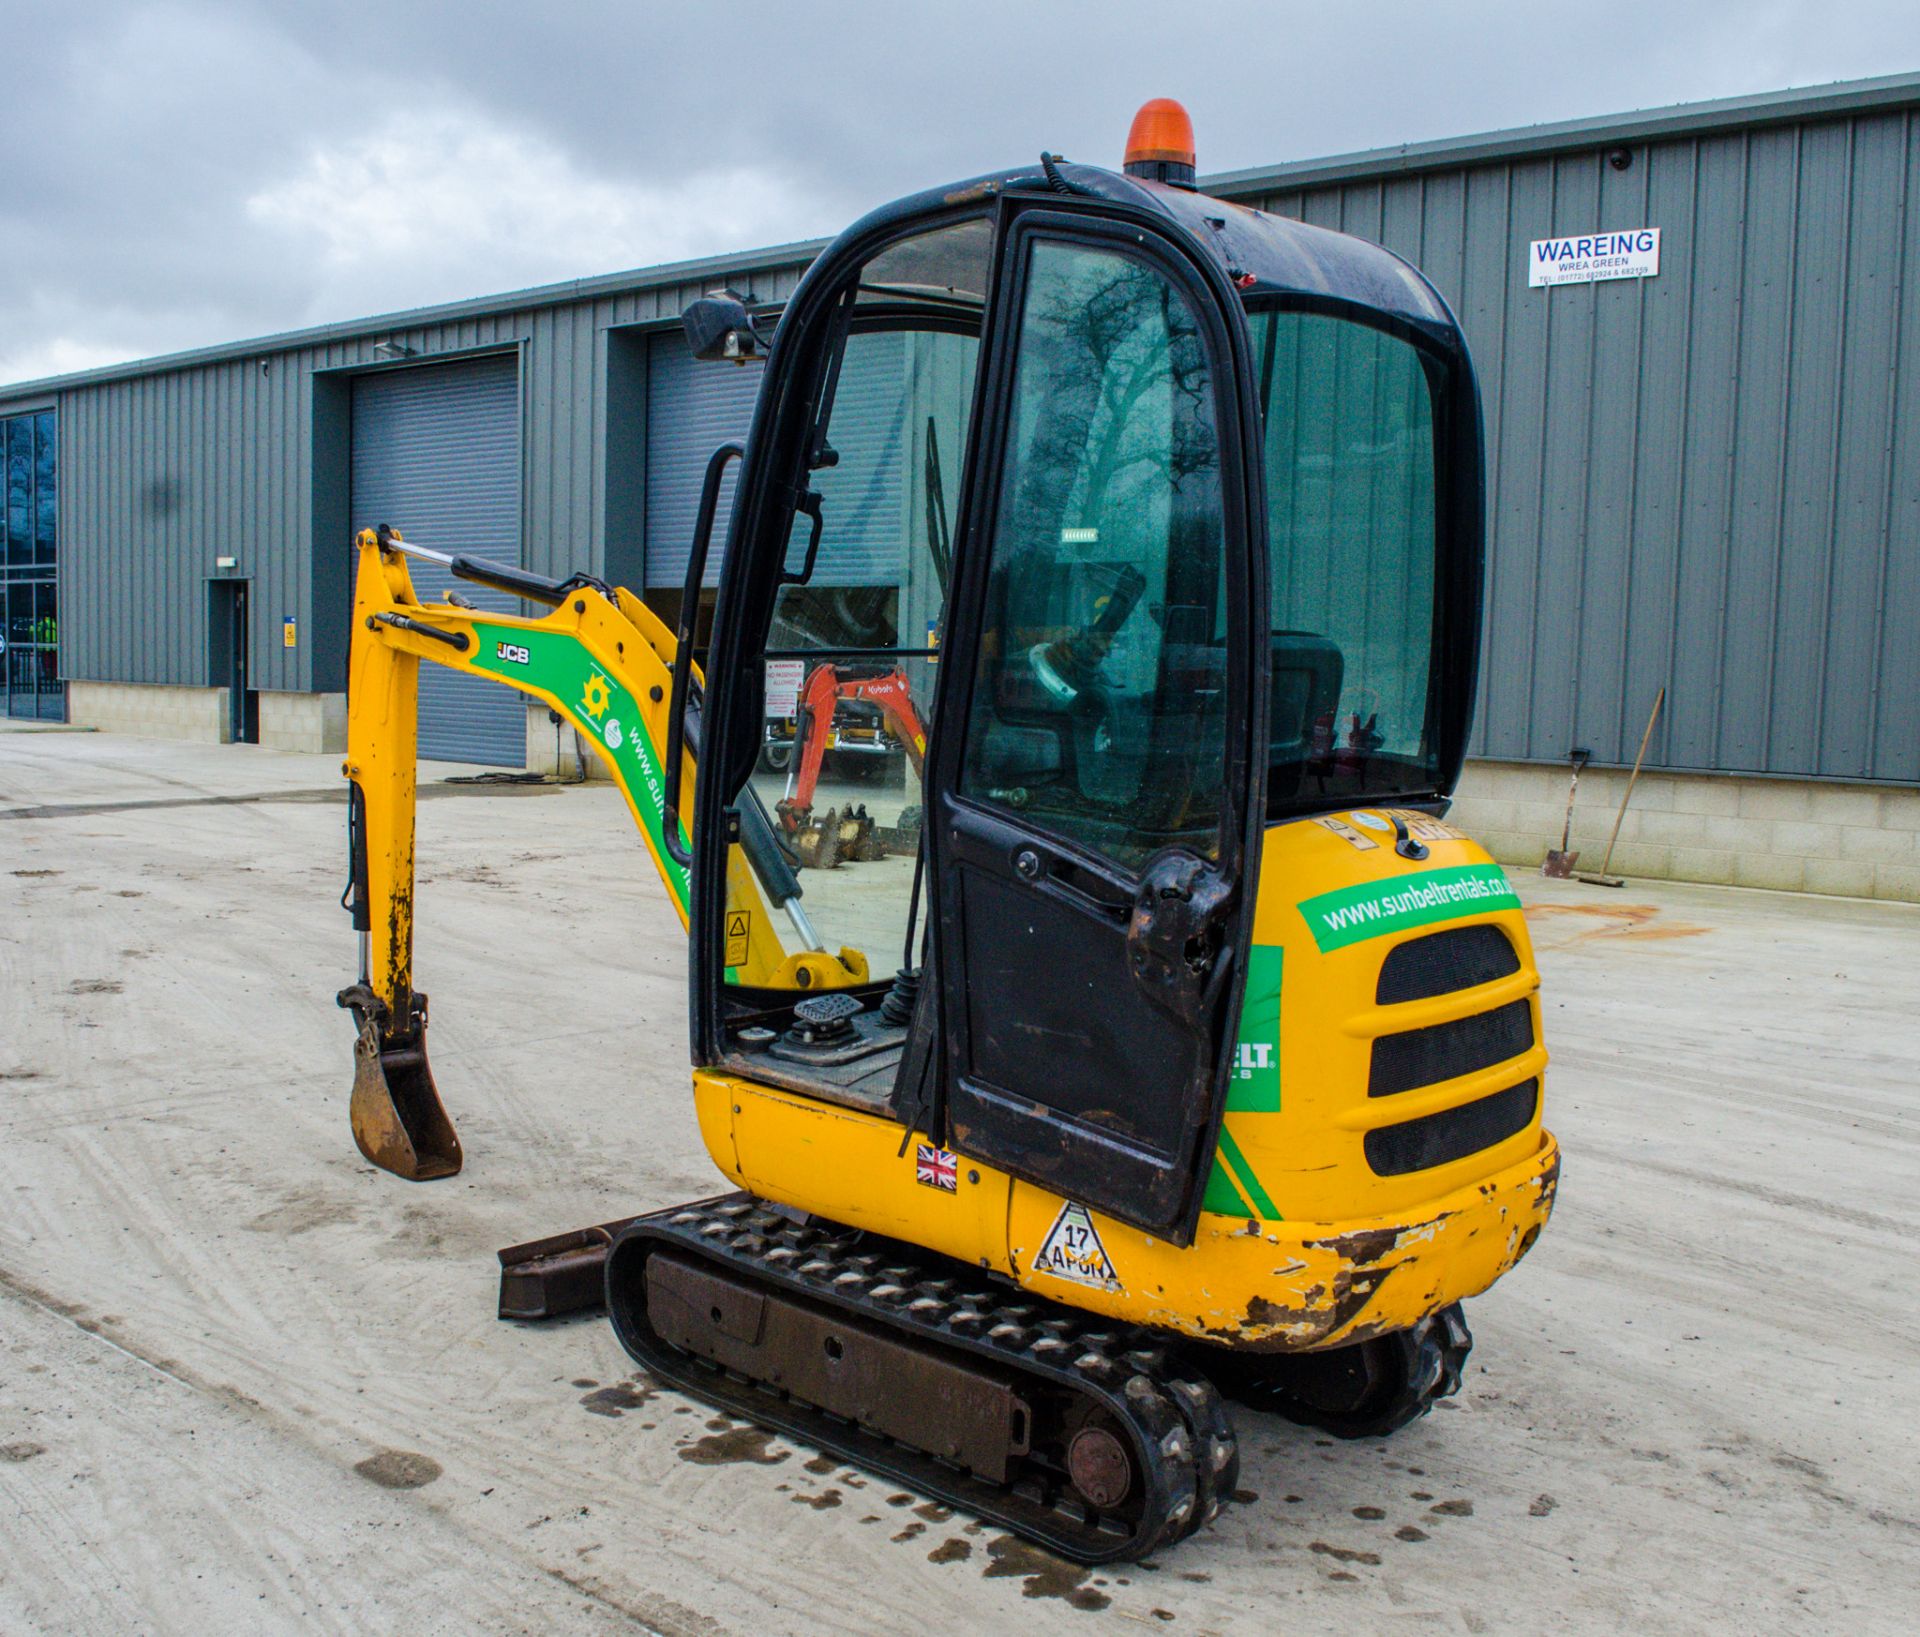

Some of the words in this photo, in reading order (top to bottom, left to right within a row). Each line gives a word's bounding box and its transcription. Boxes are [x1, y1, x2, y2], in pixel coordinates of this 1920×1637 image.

[1537, 231, 1654, 262] WAREING
[1558, 261, 1589, 272] WREA
[1592, 256, 1629, 268] GREEN
[497, 642, 529, 664] JCB
[628, 726, 664, 820] www.sun
[1065, 1224, 1088, 1250] 17
